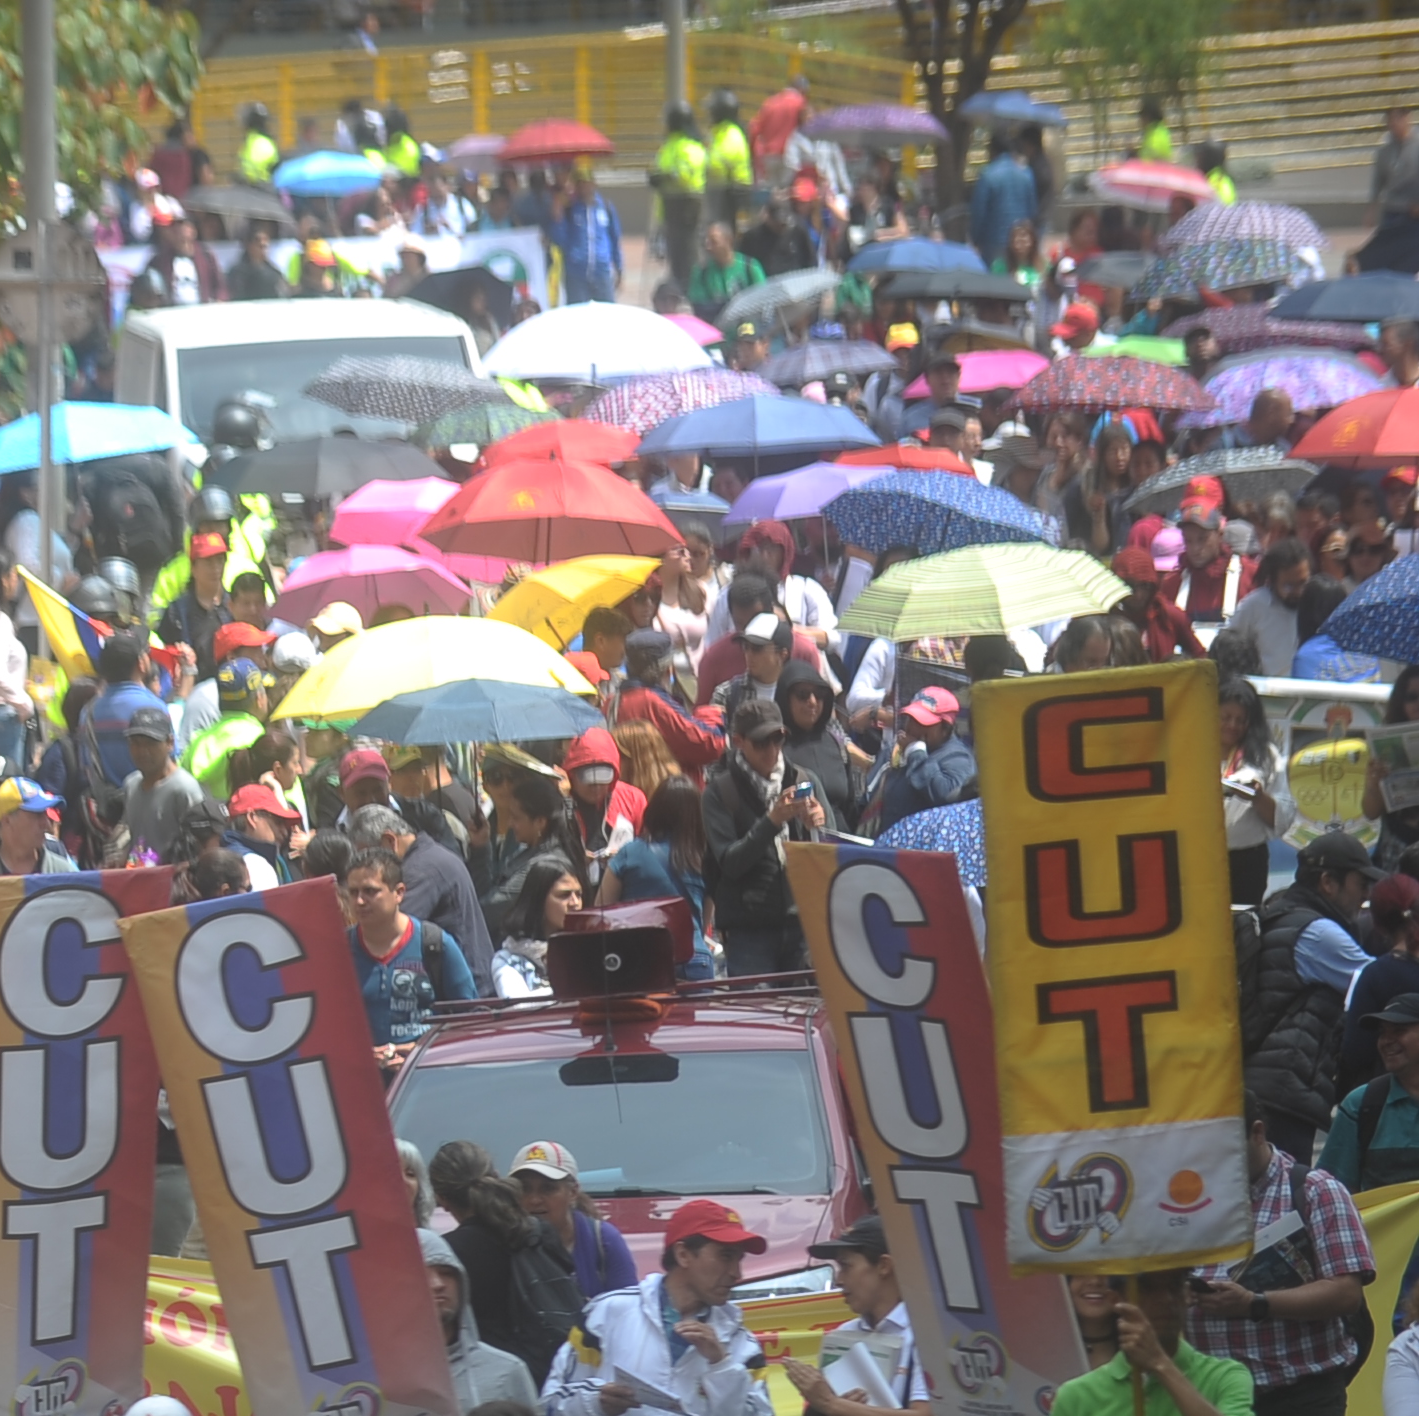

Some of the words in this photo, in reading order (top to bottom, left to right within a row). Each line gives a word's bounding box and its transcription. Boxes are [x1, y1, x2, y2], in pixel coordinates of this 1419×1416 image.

[828, 859, 983, 1312] CUT
[1023, 687, 1181, 1113] CUT
[175, 909, 360, 1371] CUT
